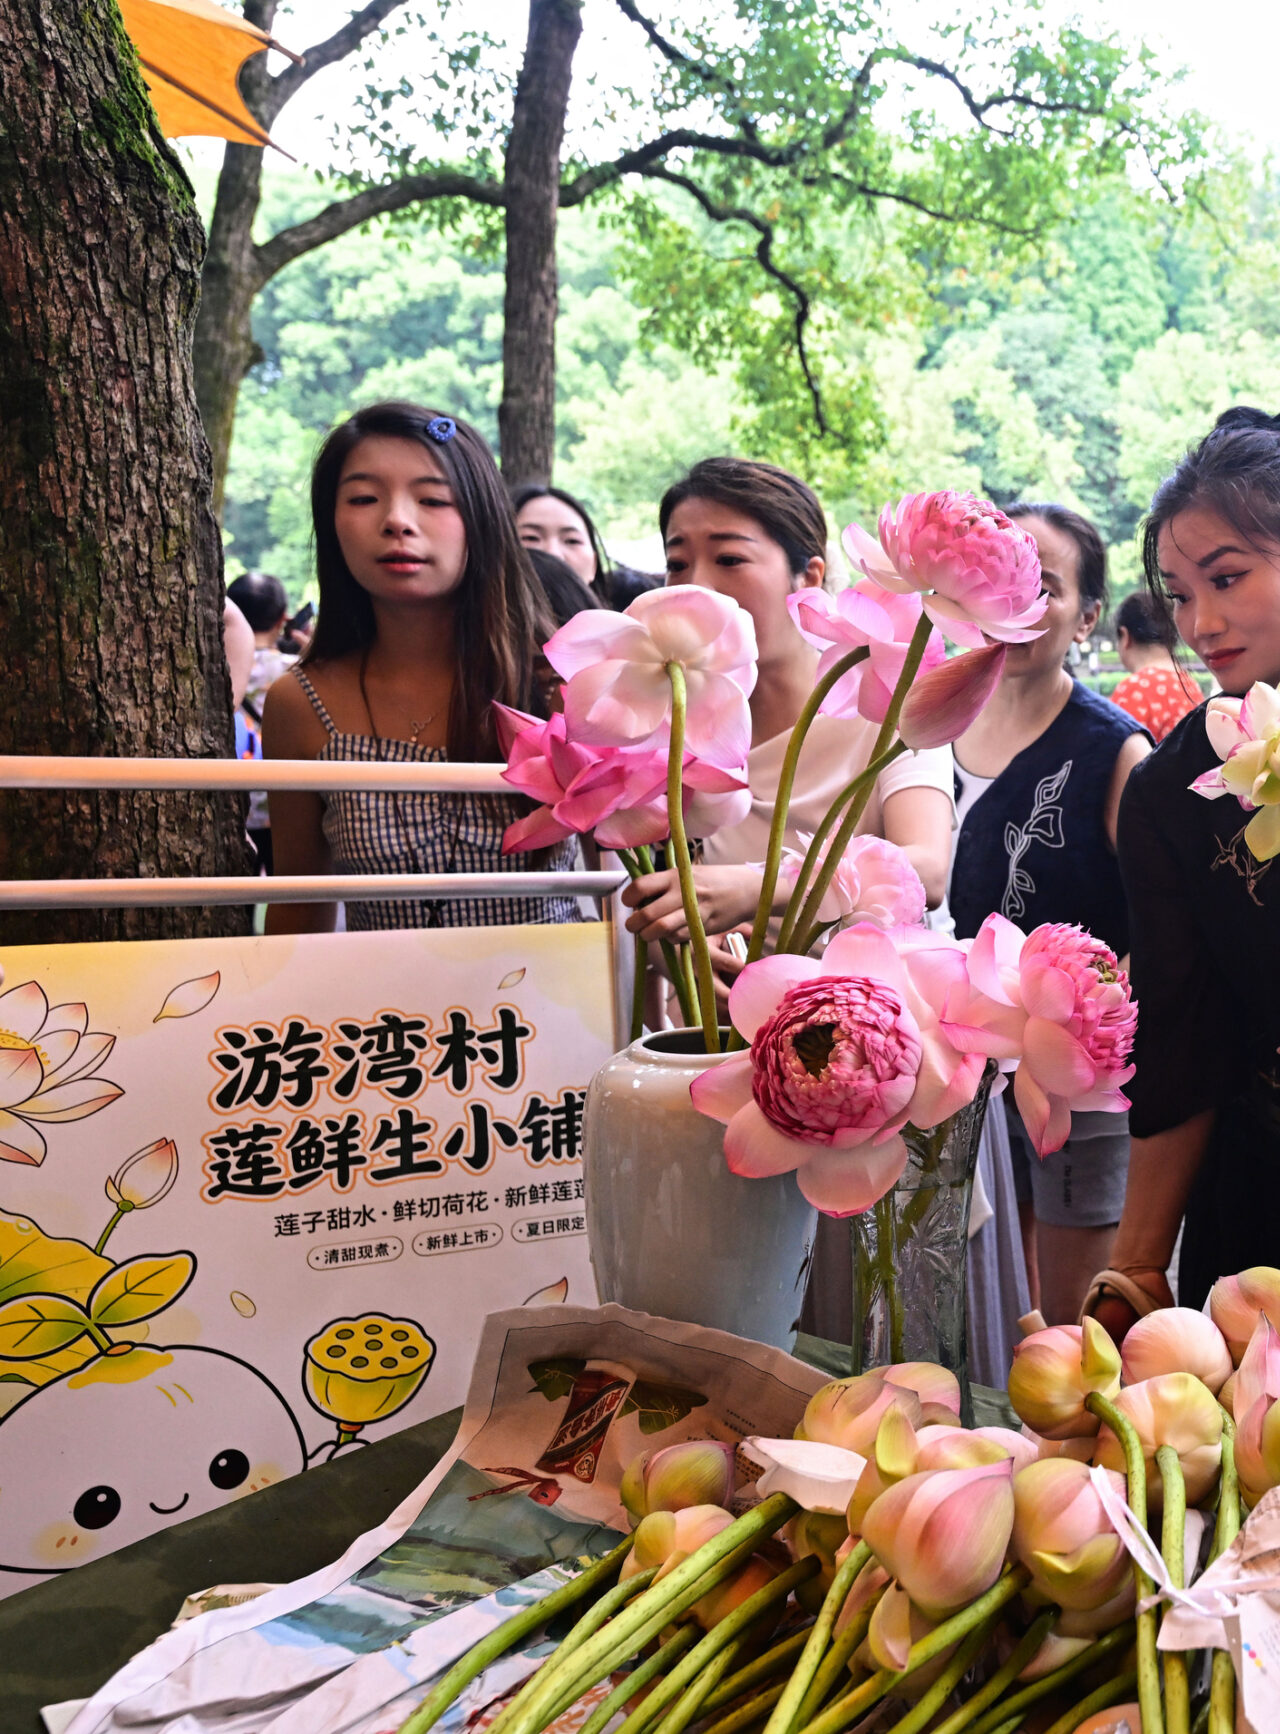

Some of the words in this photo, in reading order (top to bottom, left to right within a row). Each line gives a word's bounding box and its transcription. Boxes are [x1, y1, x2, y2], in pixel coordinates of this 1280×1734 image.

[214, 1008, 531, 1109] 游湾村
[207, 1092, 584, 1198] 莲鲜生小铺
